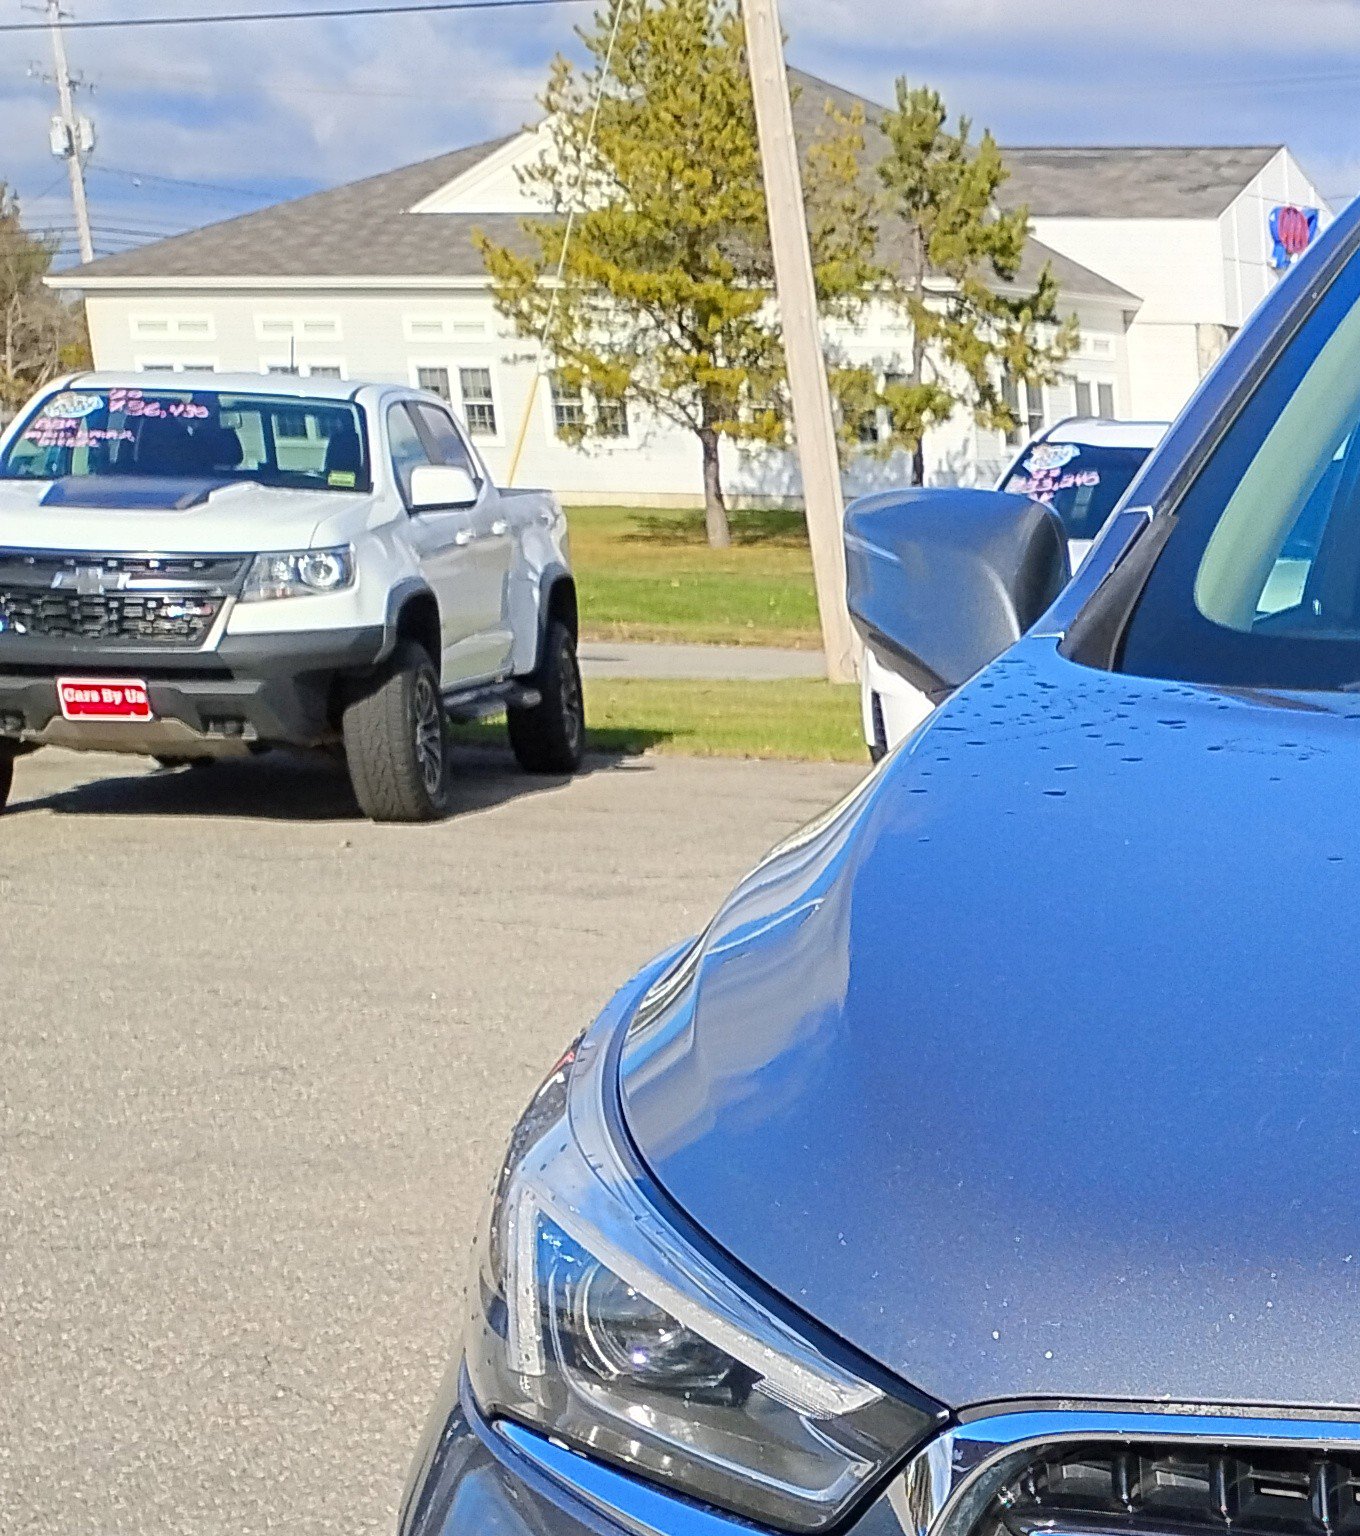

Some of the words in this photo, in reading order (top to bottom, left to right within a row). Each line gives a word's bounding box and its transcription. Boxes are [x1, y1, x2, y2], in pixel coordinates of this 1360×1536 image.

[63, 687, 100, 703] Cars
[101, 688, 123, 705] By
[124, 688, 147, 704] Us
